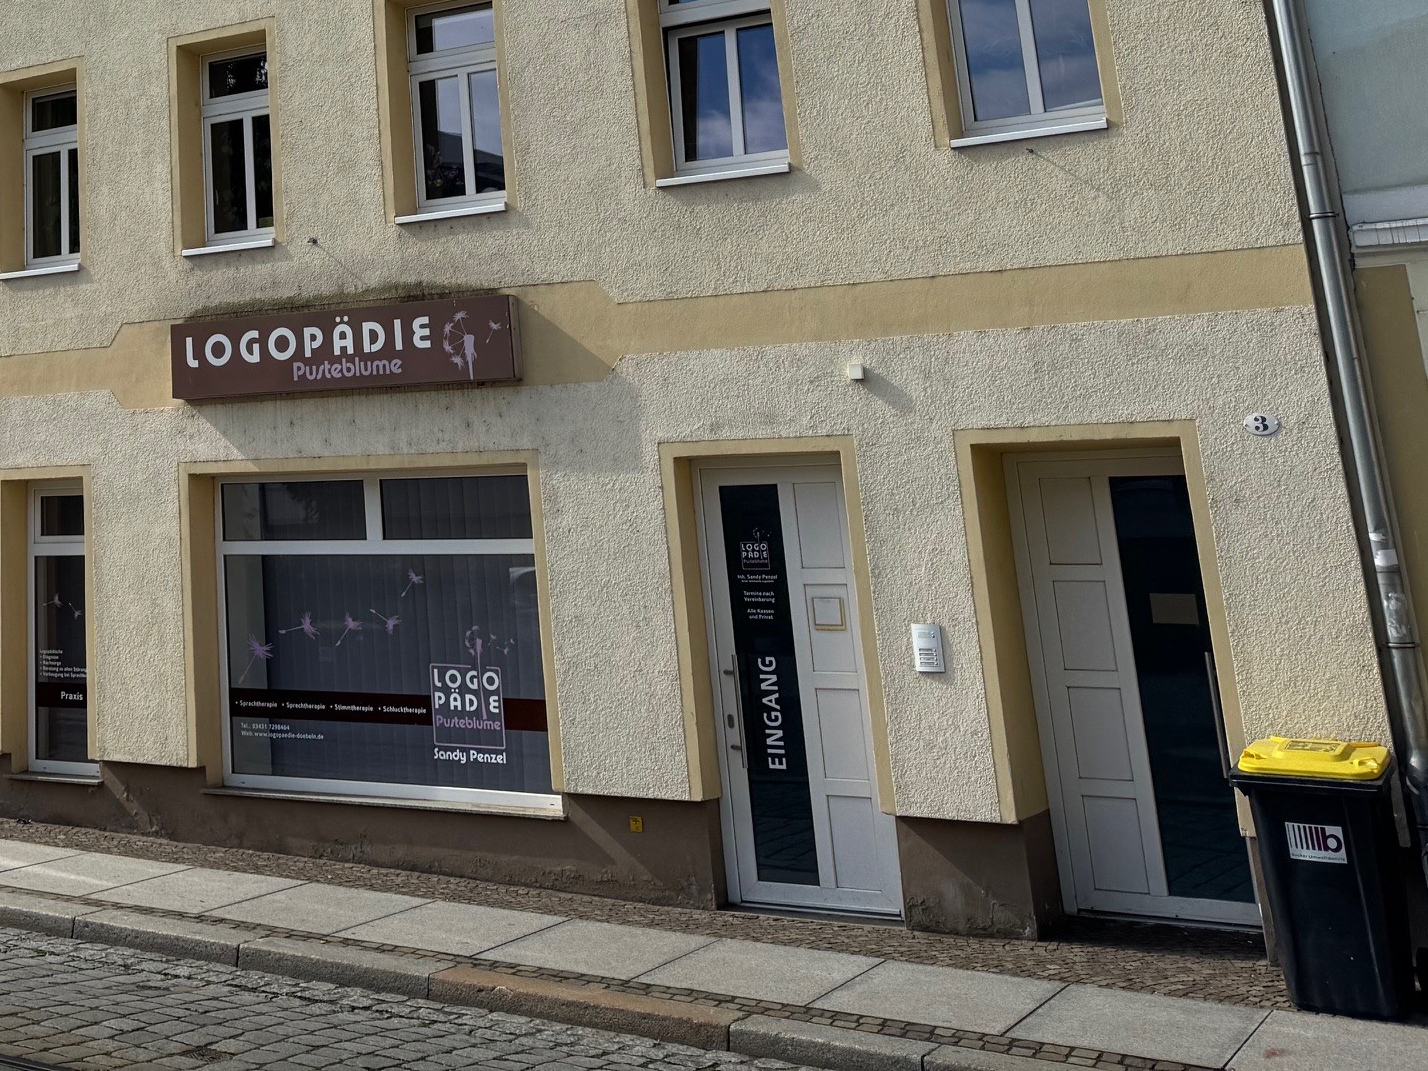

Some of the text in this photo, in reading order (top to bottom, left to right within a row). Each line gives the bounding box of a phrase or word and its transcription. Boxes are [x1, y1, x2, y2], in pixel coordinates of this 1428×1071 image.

[185, 315, 432, 368] LOGOPÄDIE
[292, 357, 403, 381] Pusteblume
[1254, 415, 1269, 432] 3
[741, 543, 767, 551] LOGO
[743, 596, 775, 604] Vereinbarung
[433, 668, 499, 691] LOGO
[60, 690, 84, 701] Praxis
[239, 699, 427, 715] Sprachtherapie Sprechtherapie Stimmtherapie Schlucktherapie
[757, 656, 787, 770] EINGANG
[435, 714, 502, 731] Pusteblume
[433, 747, 507, 765] Sandy Penzel
